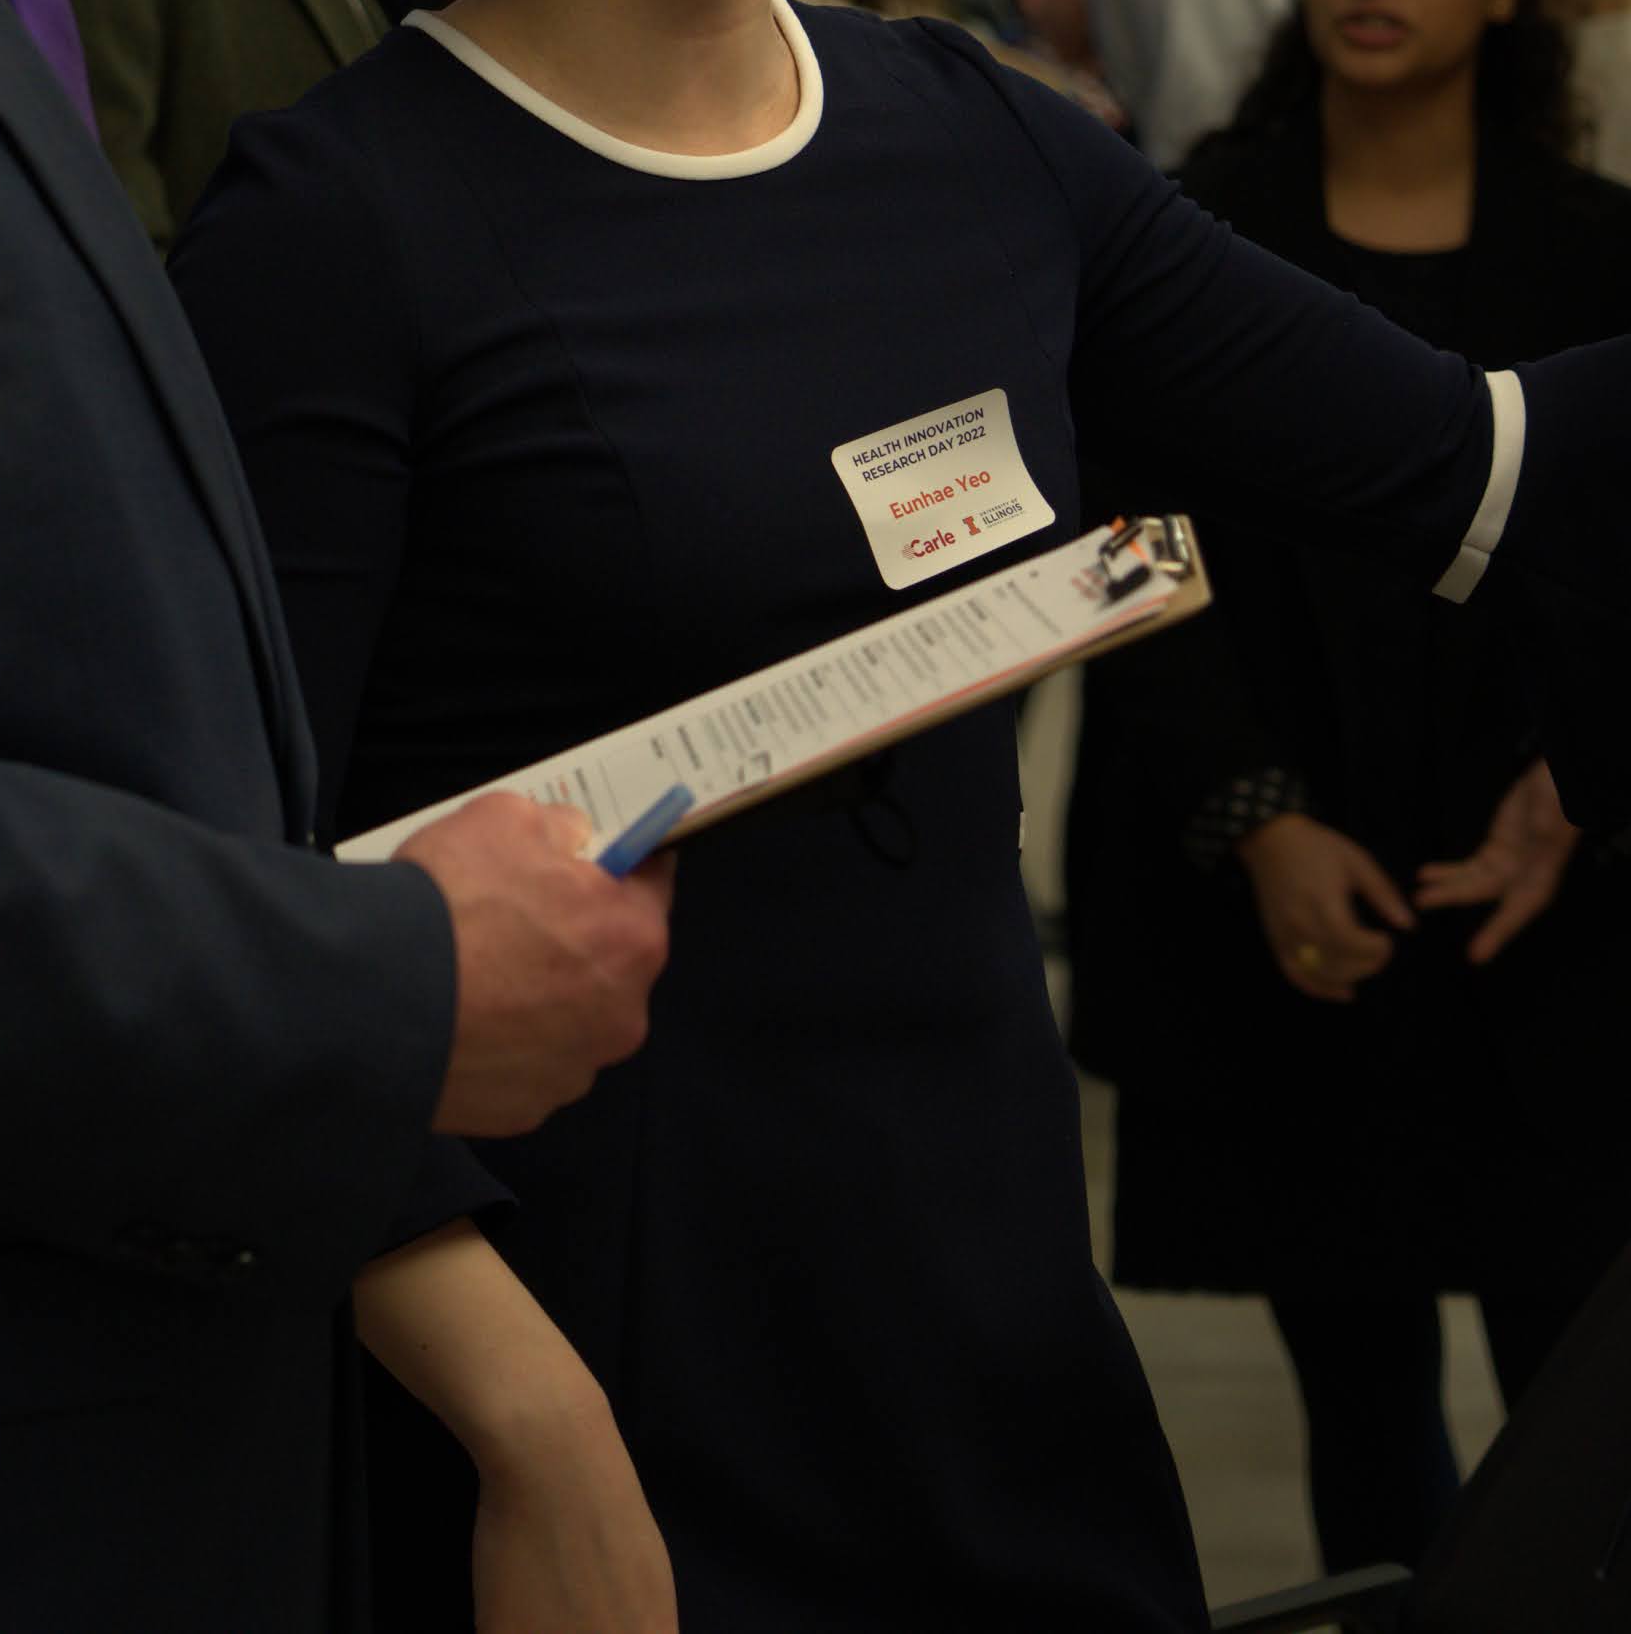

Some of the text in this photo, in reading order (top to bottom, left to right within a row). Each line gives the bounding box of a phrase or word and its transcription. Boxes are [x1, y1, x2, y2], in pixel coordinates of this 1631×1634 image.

[853, 408, 985, 467] HEALTH INNOVATION
[862, 426, 987, 482] RESEARCH DAY 2022
[889, 470, 991, 519] Eunhae Yeo
[982, 503, 1023, 525] ILLINOIS
[908, 530, 956, 558] Carle
